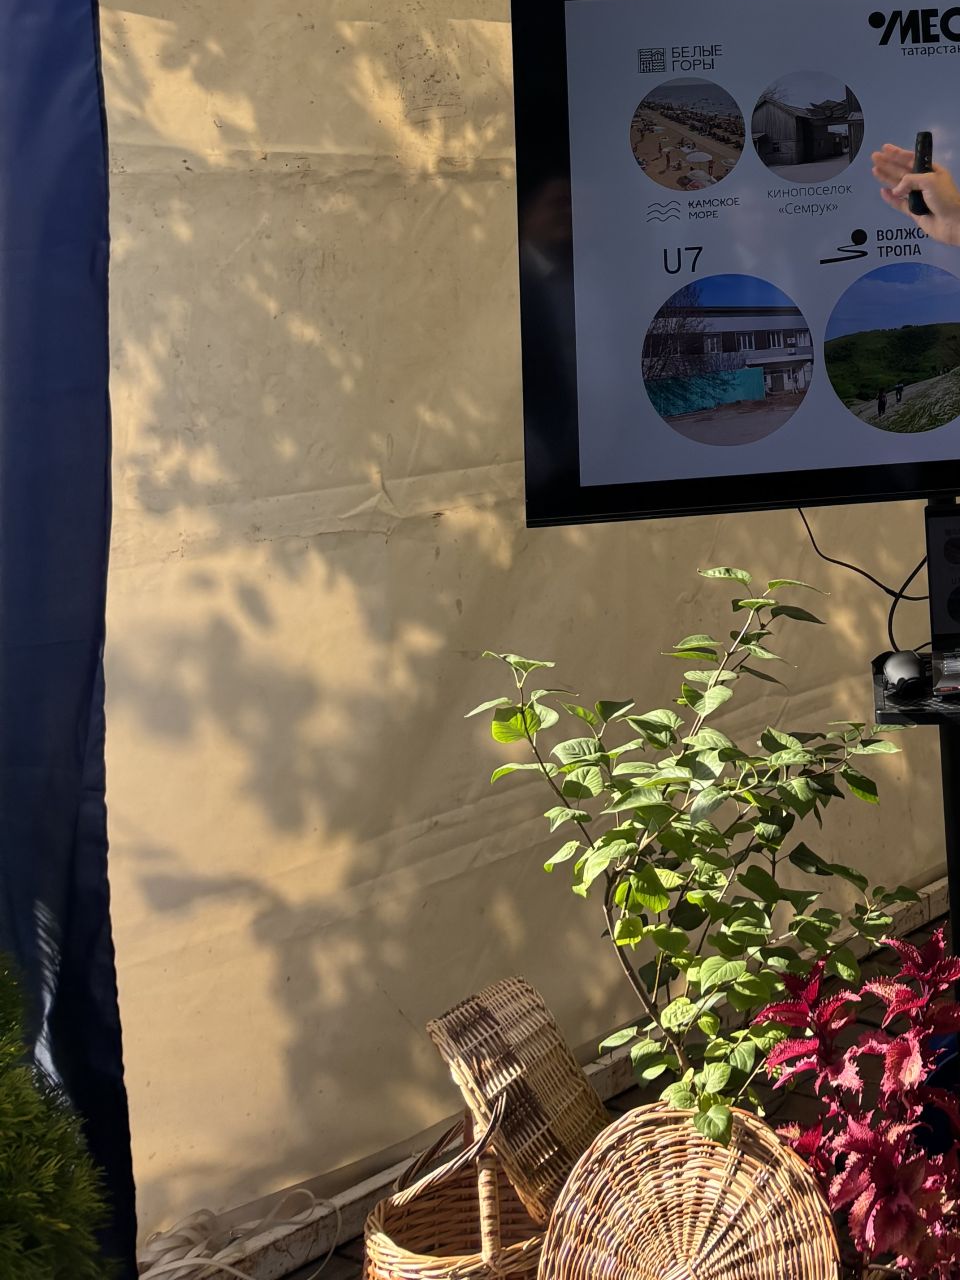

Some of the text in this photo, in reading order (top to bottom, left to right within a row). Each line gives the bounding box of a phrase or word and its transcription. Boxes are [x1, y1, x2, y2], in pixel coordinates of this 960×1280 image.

[671, 44, 723, 58] БЕЛЫЕ
[672, 58, 715, 72] ГОРЫ
[767, 183, 853, 199] кинопоселок
[687, 197, 740, 209] КАМСКОЕ
[778, 202, 839, 216] «Семрук»
[688, 210, 719, 220] МОРЕ
[876, 227, 928, 241] ВОЛЖС
[877, 243, 922, 257] ТРОПА
[663, 246, 704, 274] U7
